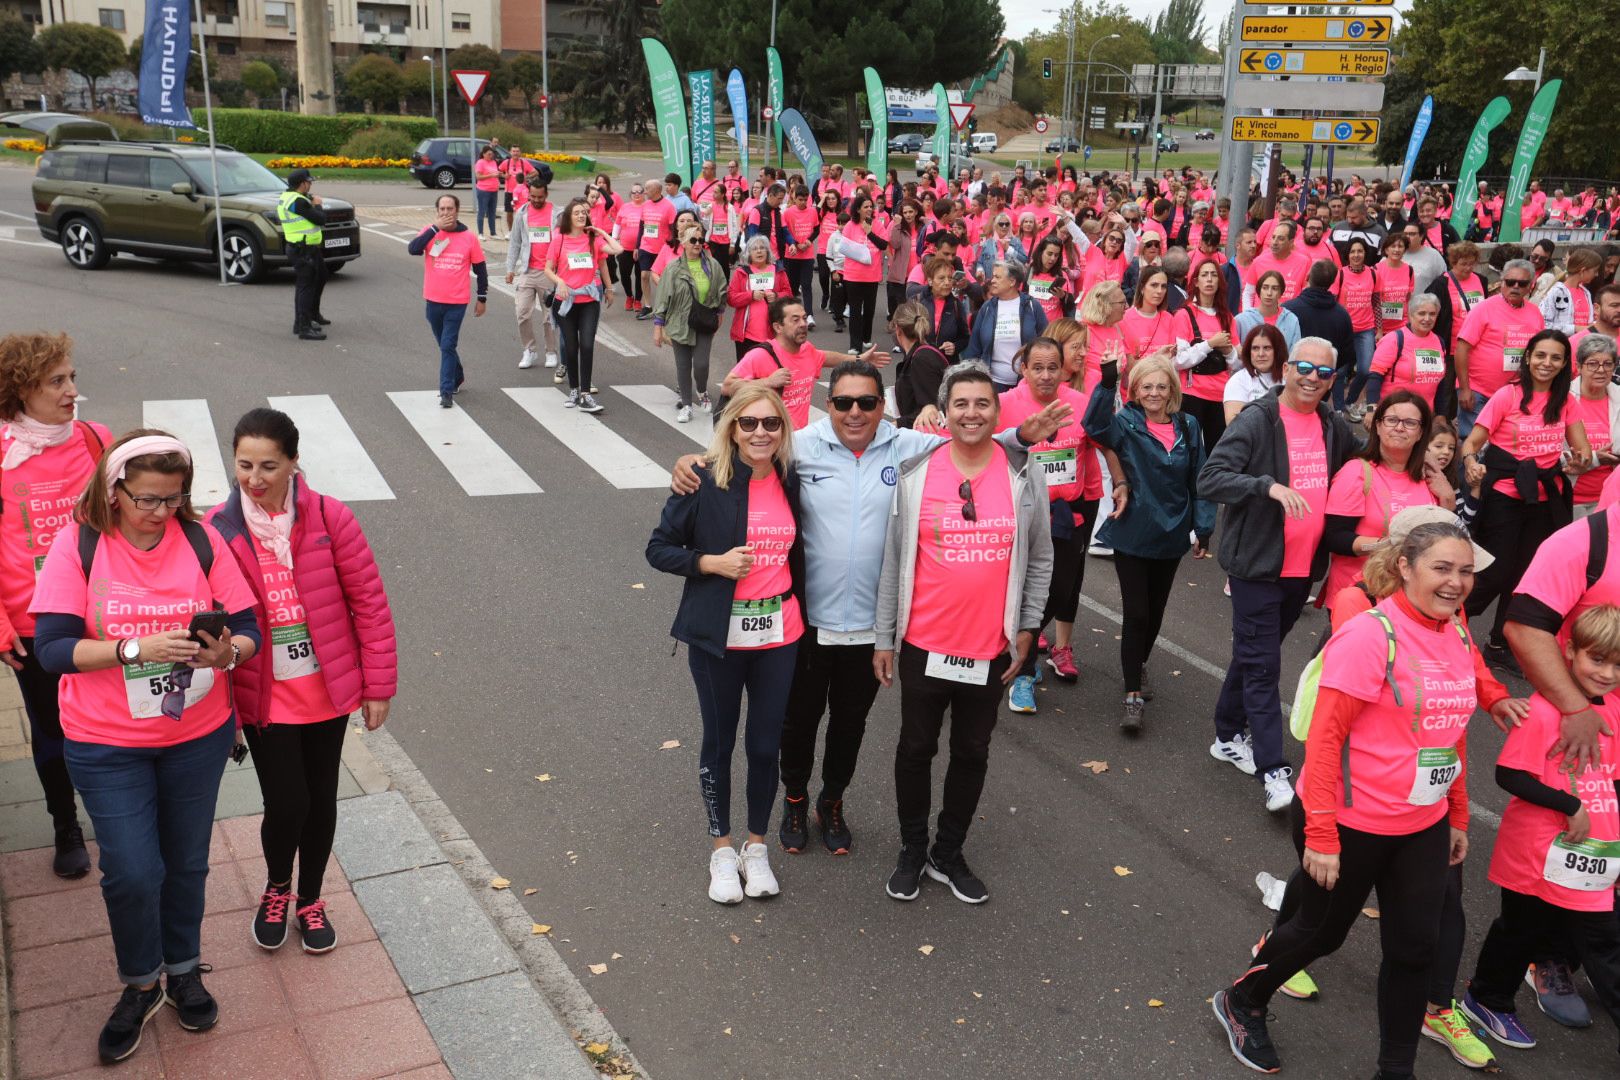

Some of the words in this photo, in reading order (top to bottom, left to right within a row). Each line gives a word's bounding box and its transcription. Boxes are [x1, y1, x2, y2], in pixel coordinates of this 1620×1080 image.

[1246, 25, 1288, 34] parador
[1340, 54, 1349, 62] H.
[1354, 54, 1384, 63] Horus
[1355, 64, 1383, 73] Regio
[1235, 121, 1244, 129] H.
[1250, 121, 1277, 129] Vincci
[1235, 130, 1243, 138] H.
[1248, 130, 1256, 138] P.
[1261, 130, 1299, 139] Romano
[326, 239, 341, 247] SANTA
[1520, 432, 1557, 442] contra
[1519, 442, 1563, 454] cánce
[1291, 451, 1302, 460] En
[1043, 462, 1066, 473] 7044
[1293, 475, 1328, 489] cánce
[30, 499, 52, 512] En
[943, 517, 960, 528] En
[747, 526, 754, 535] n
[757, 524, 796, 536] march
[746, 538, 785, 550] ontra
[944, 531, 999, 545] contra
[944, 545, 1012, 562] cáncer
[263, 572, 273, 584] n
[106, 600, 132, 615] En
[138, 599, 207, 616] marcha
[106, 619, 183, 637] contra
[741, 616, 773, 632] 6295
[943, 655, 975, 669] 7048
[149, 674, 175, 695] 53
[1423, 676, 1440, 690] En
[1425, 695, 1477, 710] contra
[1422, 710, 1471, 731] cánc
[1429, 766, 1456, 785] 9327
[1578, 778, 1616, 793] cont
[1565, 852, 1607, 875] 9330
